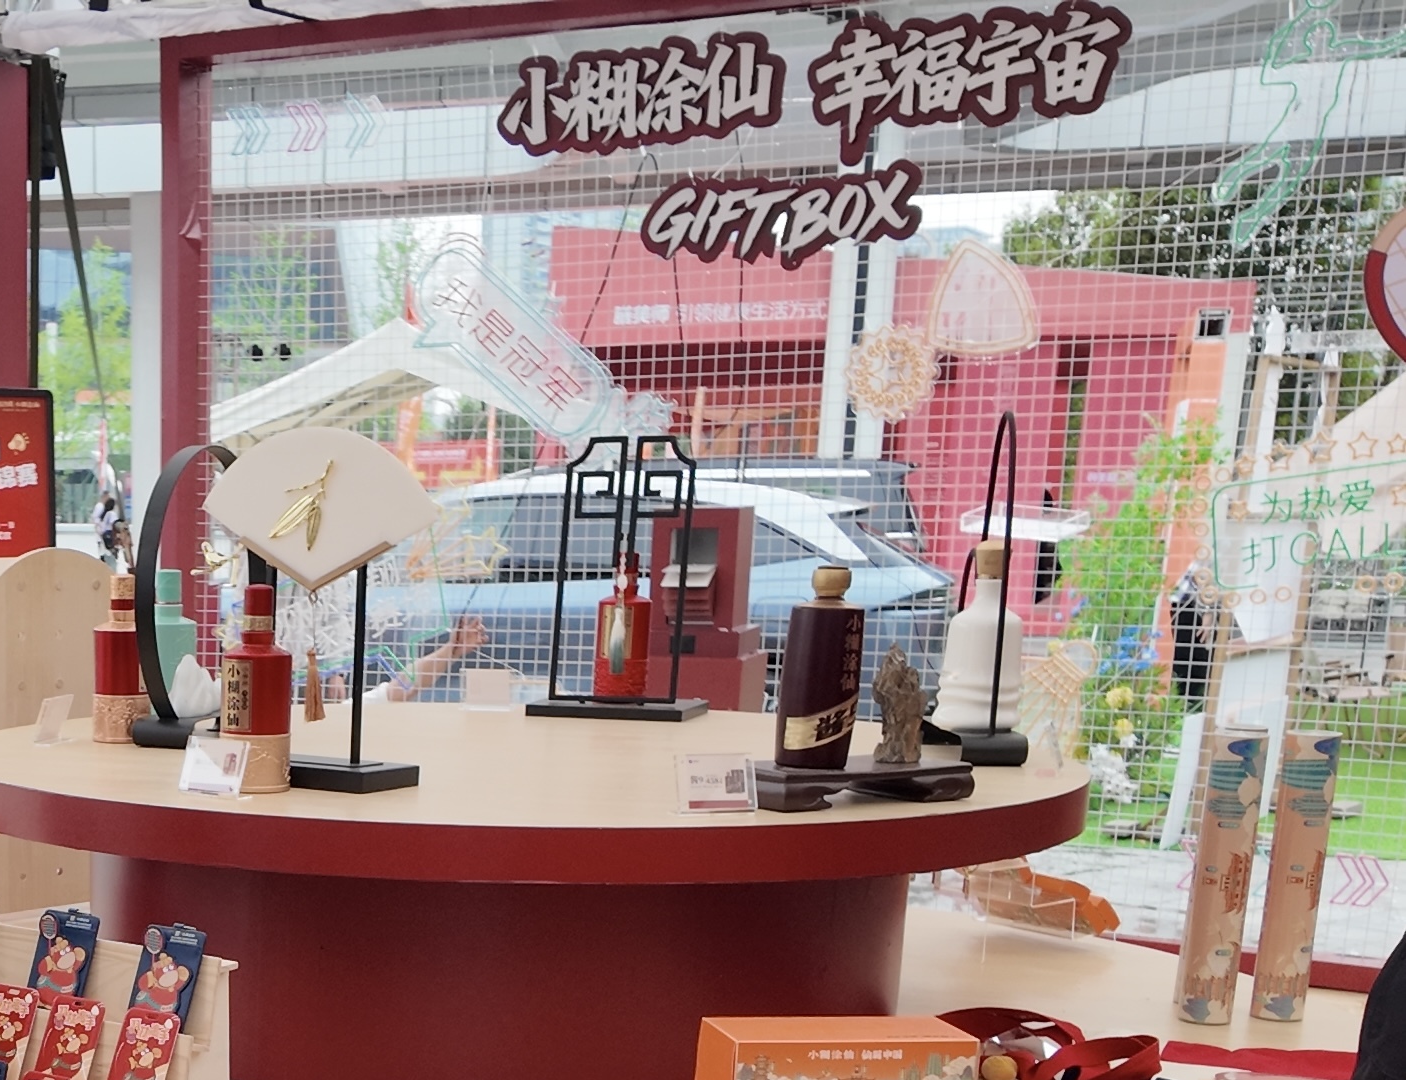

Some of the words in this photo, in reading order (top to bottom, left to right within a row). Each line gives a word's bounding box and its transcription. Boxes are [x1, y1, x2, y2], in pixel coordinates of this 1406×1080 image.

[502, 41, 774, 146] 小糊涂仙
[816, 10, 1121, 144] 幸福宇宙
[647, 186, 798, 259] GIFT
[783, 170, 910, 259] BOX
[432, 278, 583, 425] 我是冠军
[1261, 479, 1375, 524] 为热爱
[840, 613, 861, 692] 小糊涂仙
[227, 664, 241, 727] 小糊涂仙
